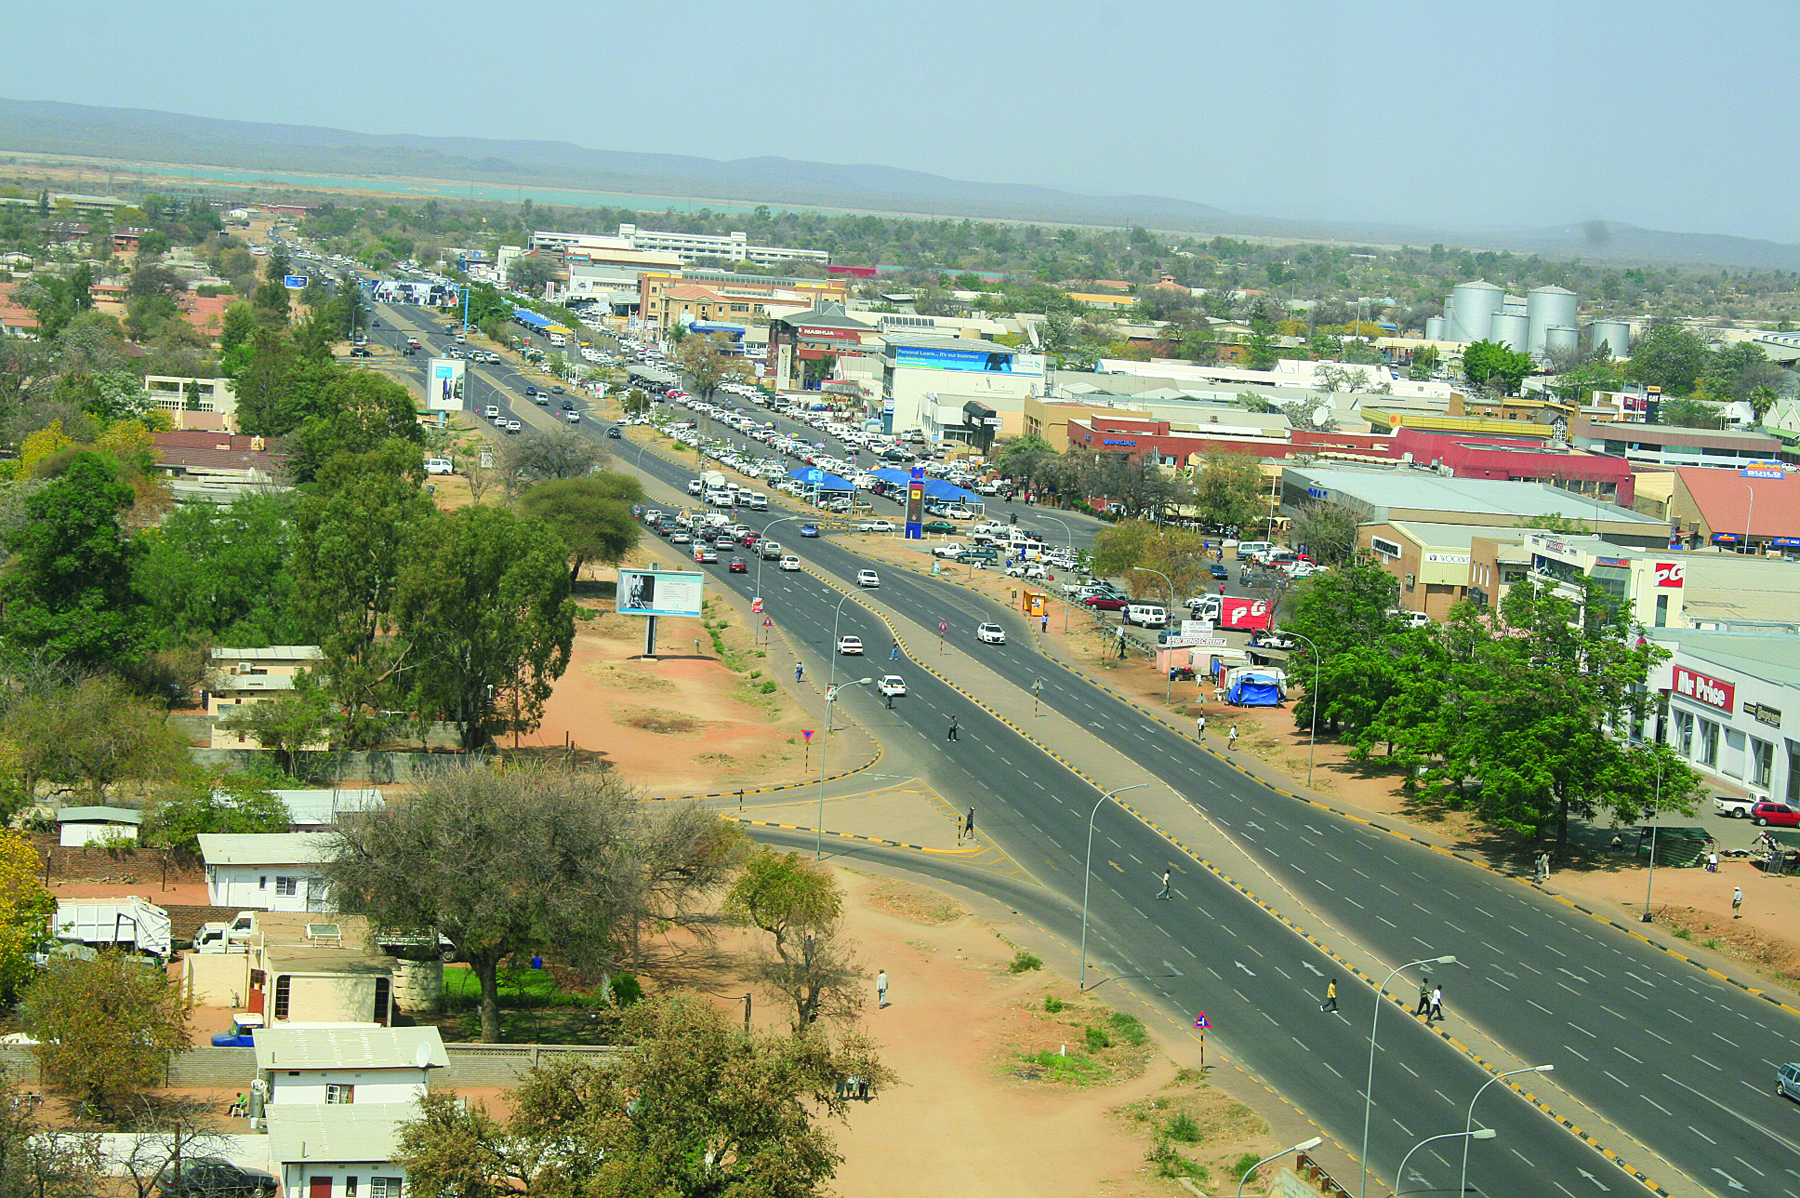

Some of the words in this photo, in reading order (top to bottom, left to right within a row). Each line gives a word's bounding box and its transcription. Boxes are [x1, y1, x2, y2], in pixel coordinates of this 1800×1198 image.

[1747, 470, 1782, 478] BUILD
[1653, 564, 1685, 587] PG
[1231, 600, 1267, 625] PG
[1677, 670, 1694, 696] Mr
[1696, 676, 1726, 707] Price
